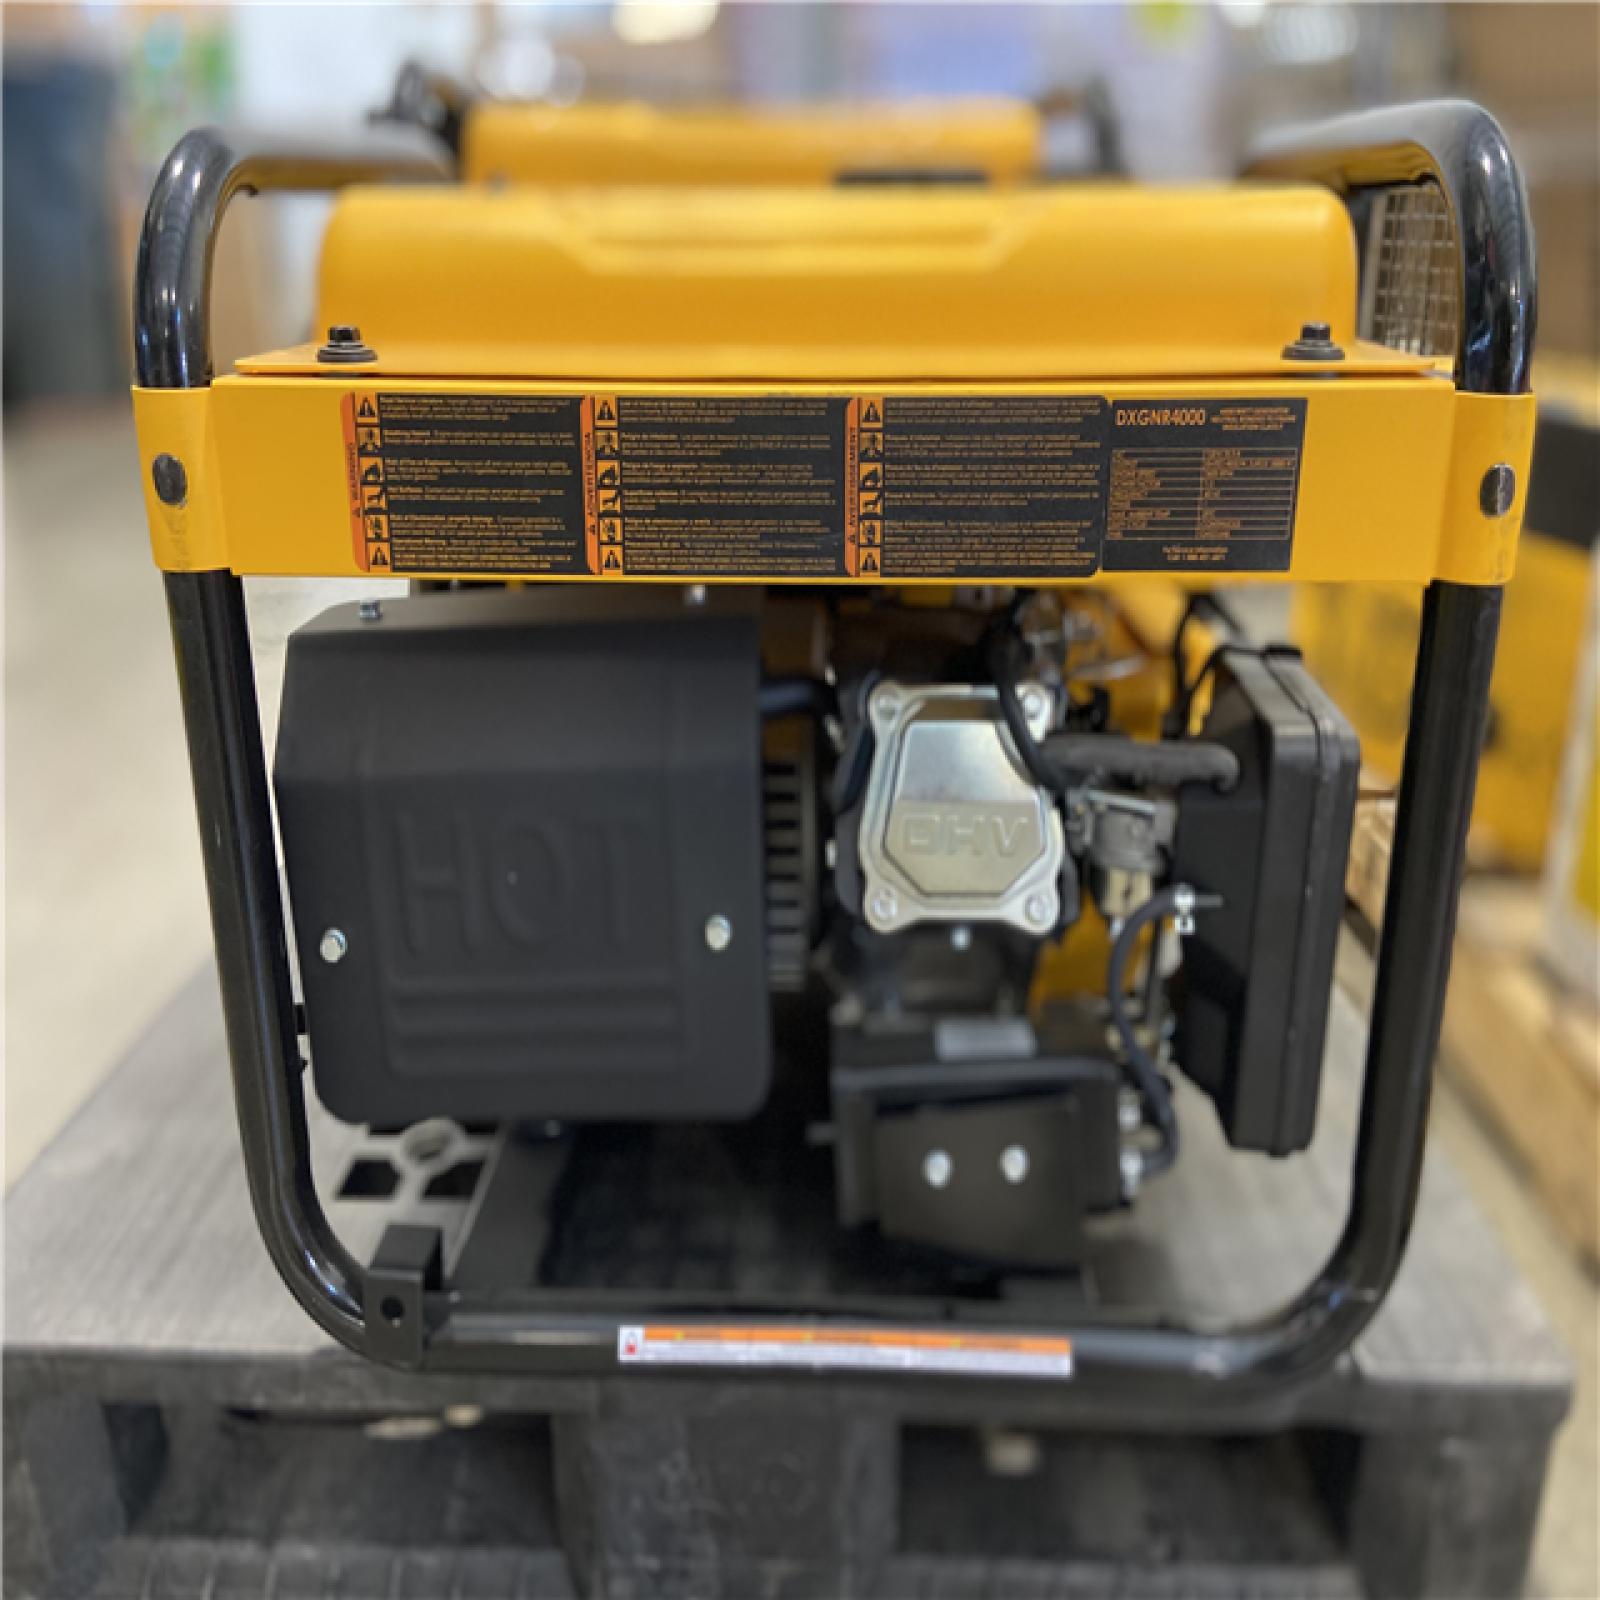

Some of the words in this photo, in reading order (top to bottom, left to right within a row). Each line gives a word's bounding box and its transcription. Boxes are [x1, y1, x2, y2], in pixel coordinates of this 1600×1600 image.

[1114, 408, 1207, 426] DXGNR4000
[901, 814, 1029, 858] OHV
[393, 810, 650, 954] HOT
